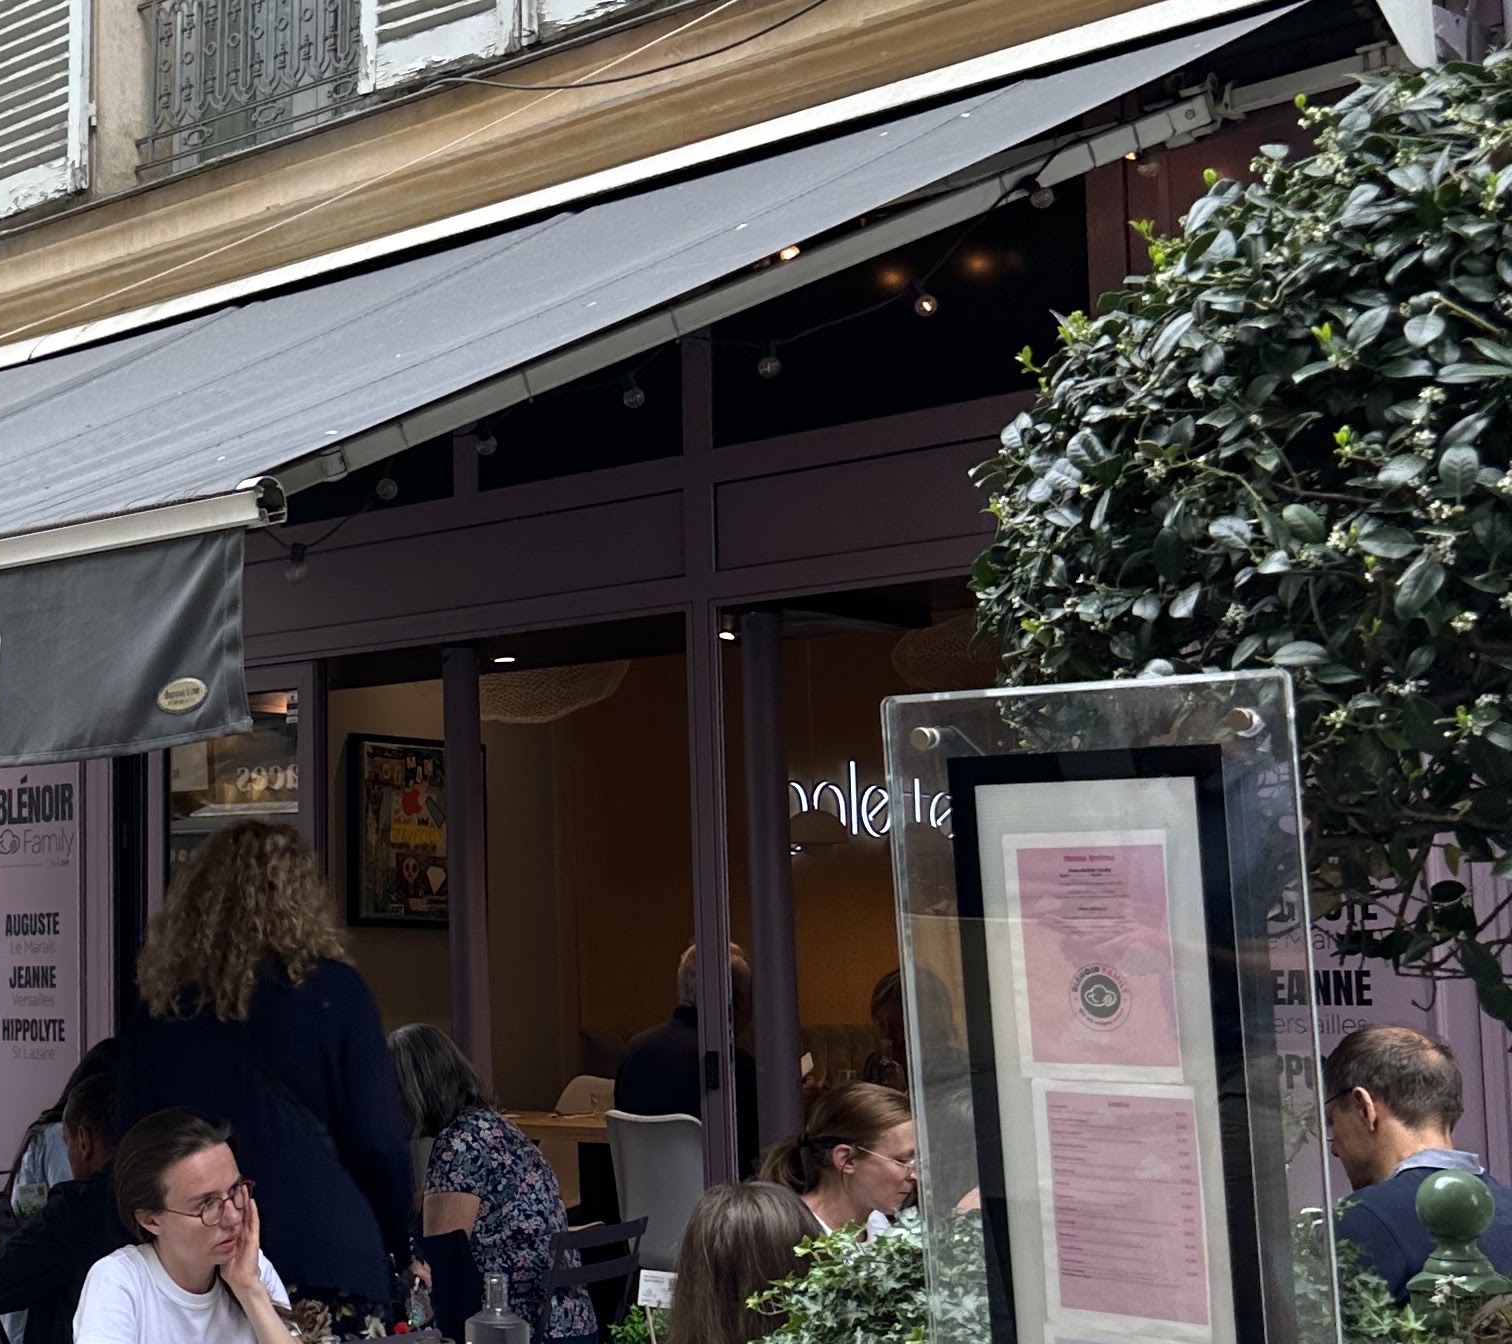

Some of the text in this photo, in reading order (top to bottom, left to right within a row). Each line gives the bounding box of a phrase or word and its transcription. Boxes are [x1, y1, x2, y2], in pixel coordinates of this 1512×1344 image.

[23, 826, 74, 857] Family
[5, 912, 60, 937] AUGUSTE
[24, 940, 56, 955] Marais
[9, 965, 57, 989] JEANNE
[1270, 969, 1373, 1007] EANNE
[11, 992, 55, 1007] Versailles
[2, 1018, 66, 1043] HIPPOLYTE
[1273, 1013, 1368, 1036] ersailles
